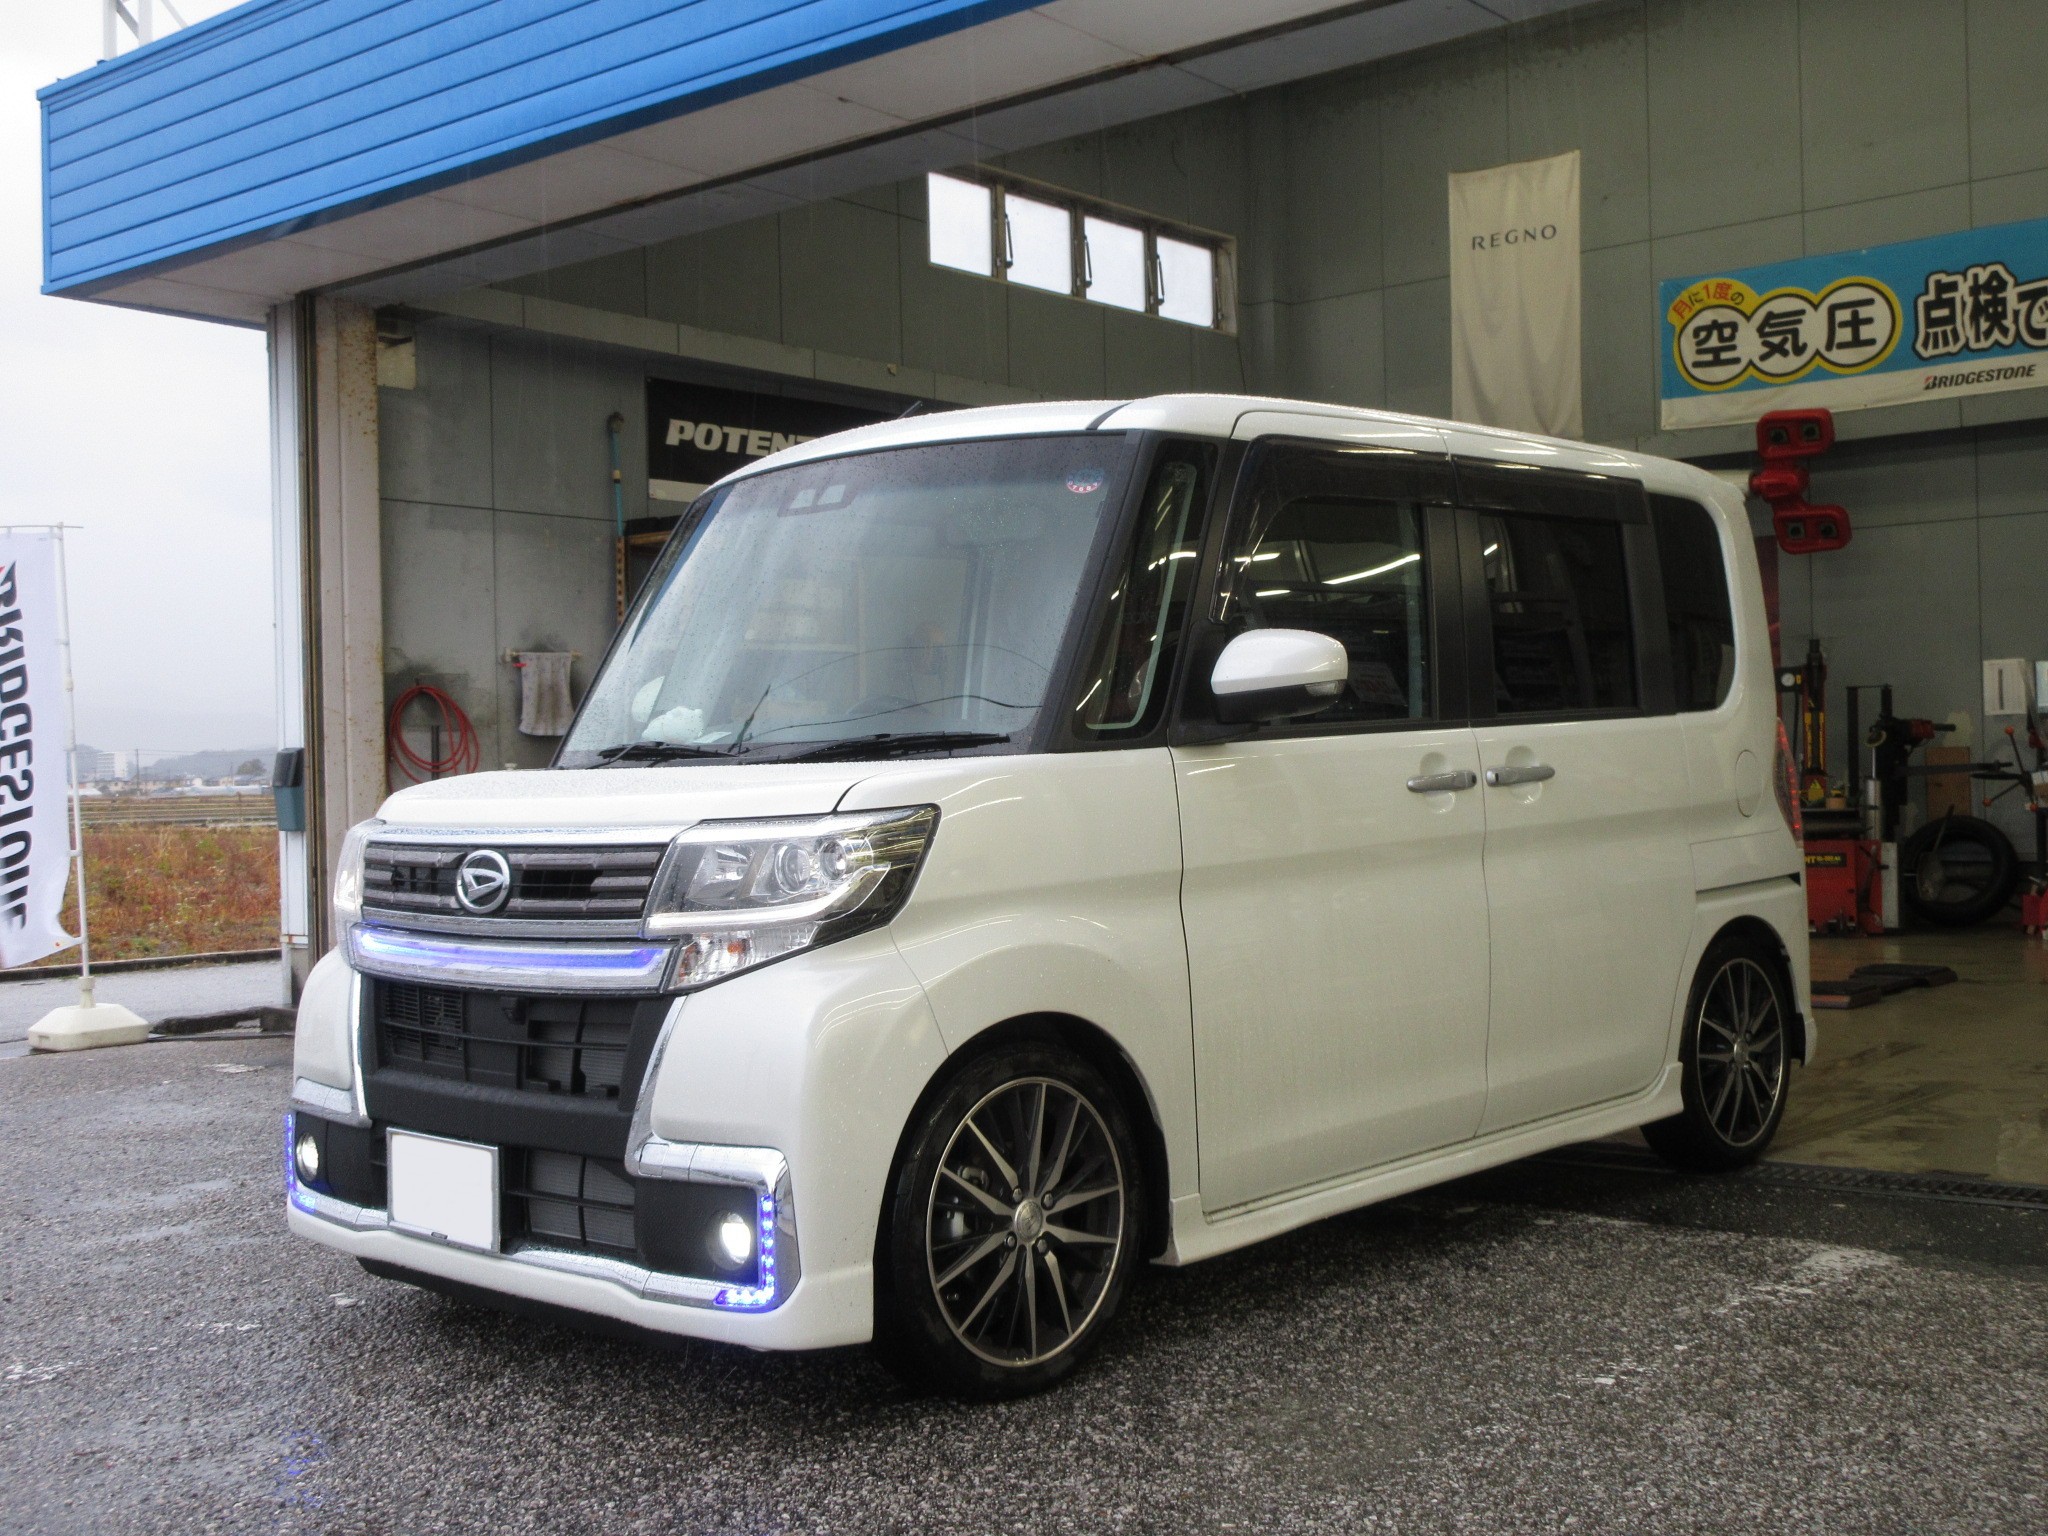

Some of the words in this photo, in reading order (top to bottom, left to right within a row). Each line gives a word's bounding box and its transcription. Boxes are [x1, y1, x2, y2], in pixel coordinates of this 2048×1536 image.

[1471, 224, 1557, 251] REGNO
[1672, 281, 1745, 320] 月に1度の
[1691, 297, 1877, 369] 空気圧
[1923, 364, 2037, 390] BRIDGESTONE
[665, 418, 819, 457] POTEN
